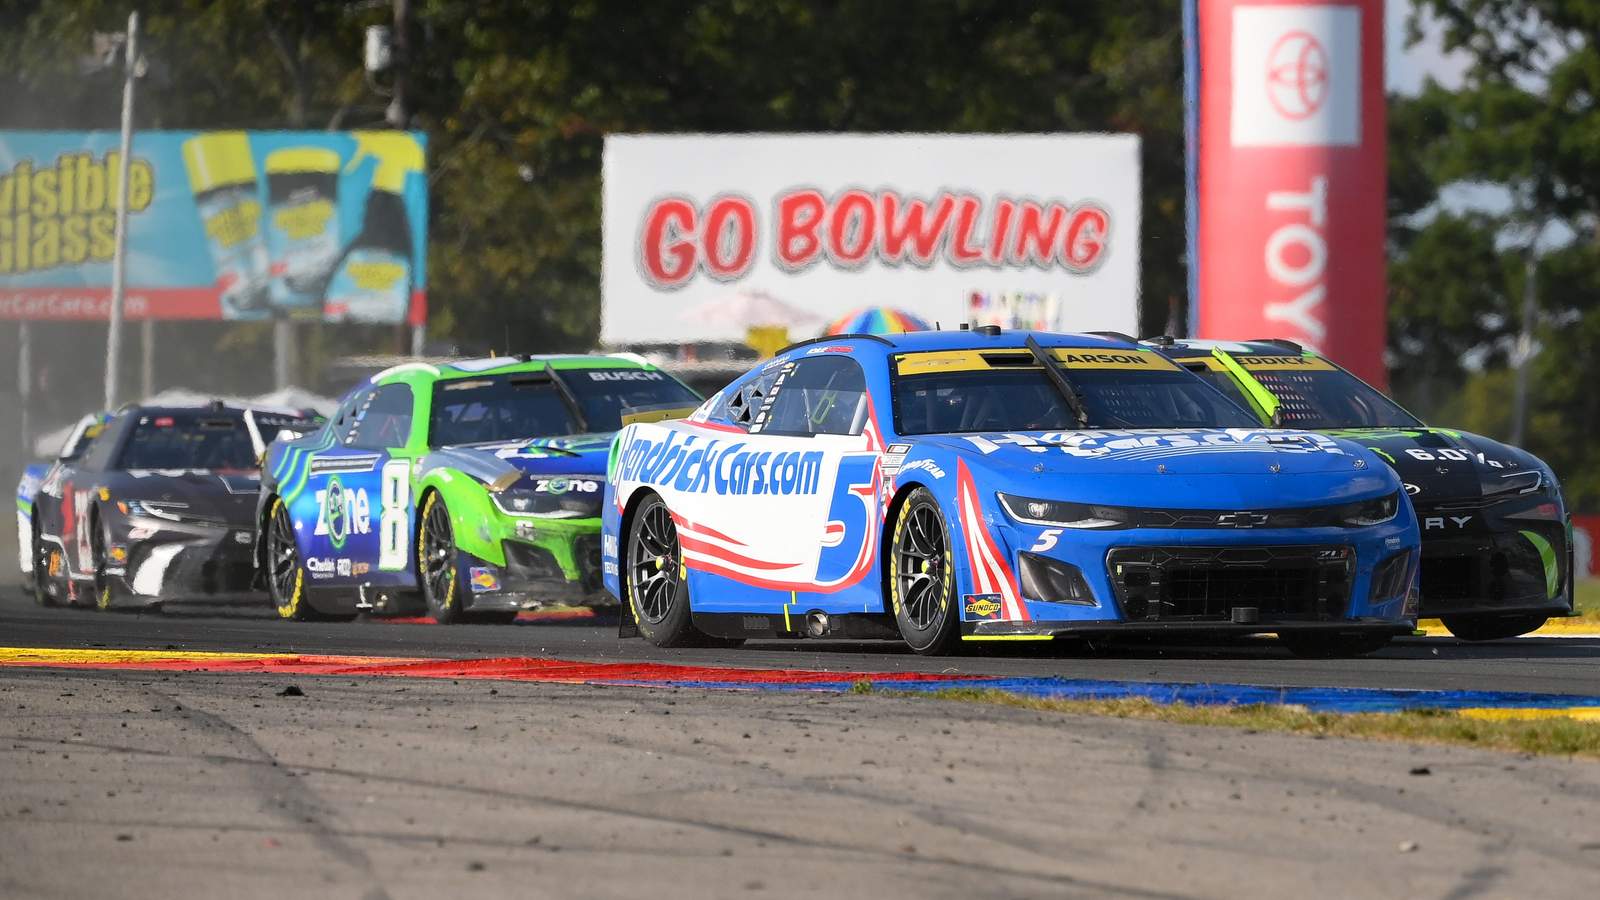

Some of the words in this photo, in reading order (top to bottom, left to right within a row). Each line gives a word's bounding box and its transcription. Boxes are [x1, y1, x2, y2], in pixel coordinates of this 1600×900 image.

[642, 197, 758, 284] GO
[778, 189, 1109, 268] BOWLING
[1263, 175, 1328, 350] TOY
[1050, 354, 1148, 364] LARSON
[1237, 356, 1311, 366] EDDICK
[589, 371, 663, 381] BUSCH
[378, 458, 410, 572] 8
[813, 455, 878, 584] 5
[1030, 529, 1064, 552] 5
[966, 604, 1000, 612] SUNOCO
